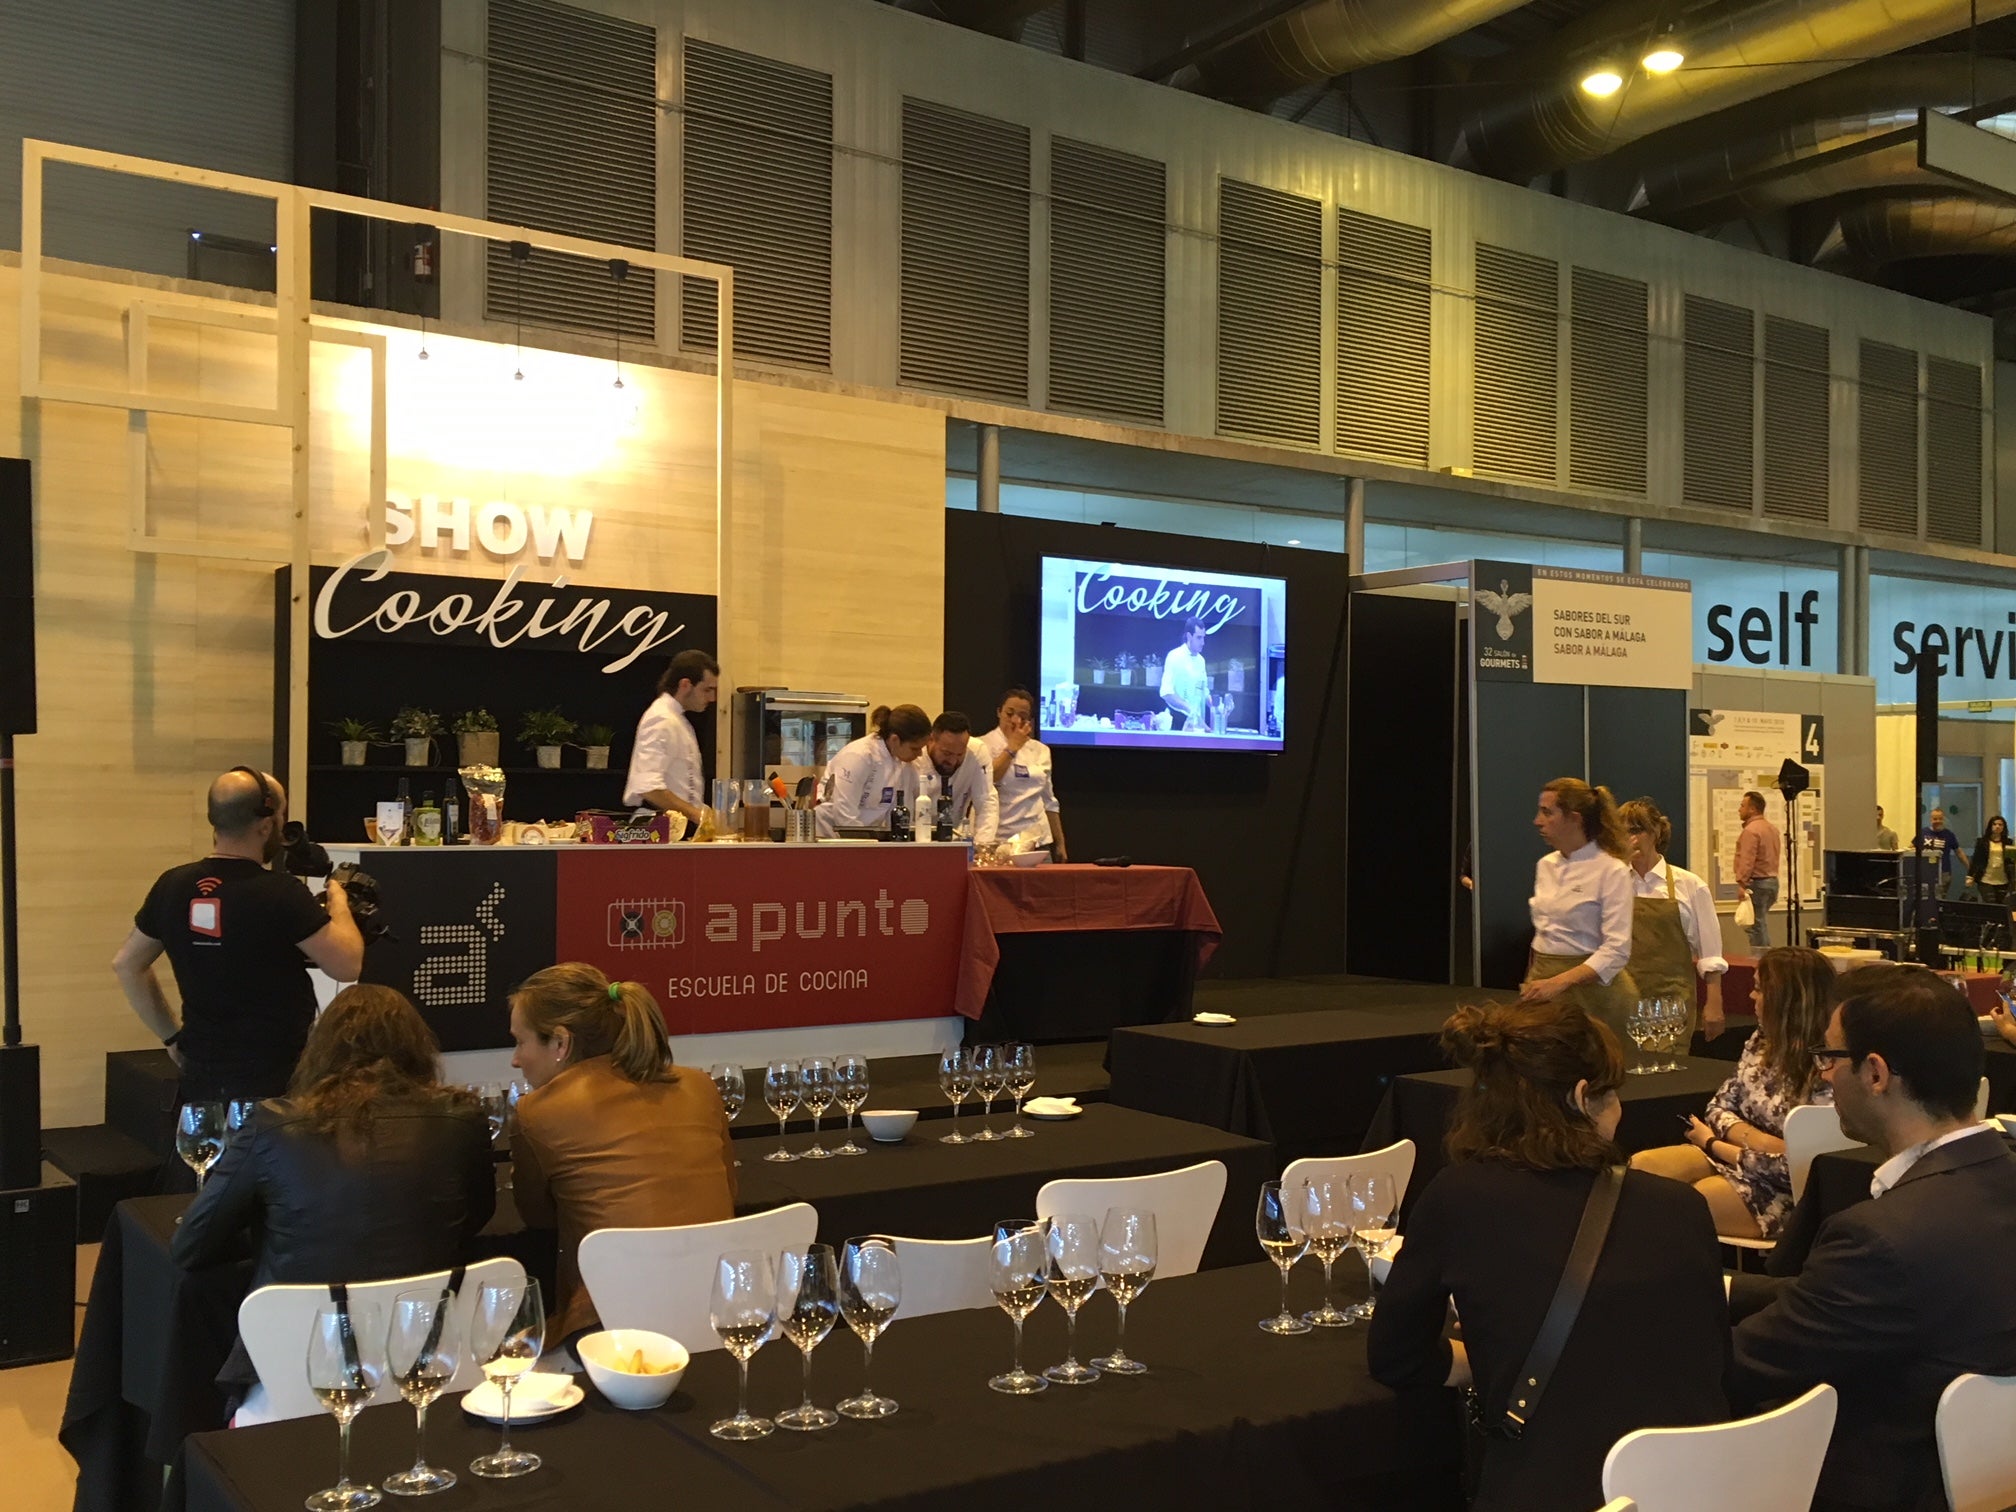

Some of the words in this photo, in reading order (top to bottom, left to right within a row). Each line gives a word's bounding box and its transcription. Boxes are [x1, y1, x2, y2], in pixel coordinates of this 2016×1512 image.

[367, 493, 594, 561] SHOW
[1537, 568, 1547, 576] EN
[1550, 569, 1573, 579] ESTOS
[1575, 572, 1613, 583] MOMENTOS
[1646, 579, 1688, 590] CELEBRANDO
[314, 549, 686, 674] Cooking
[1077, 568, 1247, 635] Cooking
[1553, 609, 1594, 623] SABORES
[1596, 612, 1612, 625] DEL
[1614, 613, 1631, 626] SUR
[1706, 589, 1819, 666] self
[1553, 626, 1573, 639] CON
[1574, 627, 1603, 641] SABOR
[1604, 628, 1612, 641] A
[1613, 627, 1646, 643] MÁLAGA
[1480, 658, 1521, 670] GOURMETS
[1483, 646, 1494, 658] 32
[1553, 643, 1584, 657] SABOR
[1585, 645, 1592, 656] A
[1593, 643, 1628, 658] MÁLAGA
[1805, 722, 1820, 757] 4
[705, 889, 929, 952] apunto
[668, 974, 756, 999] ESCUELA
[765, 973, 788, 994] DE
[800, 969, 869, 992] COCINA
